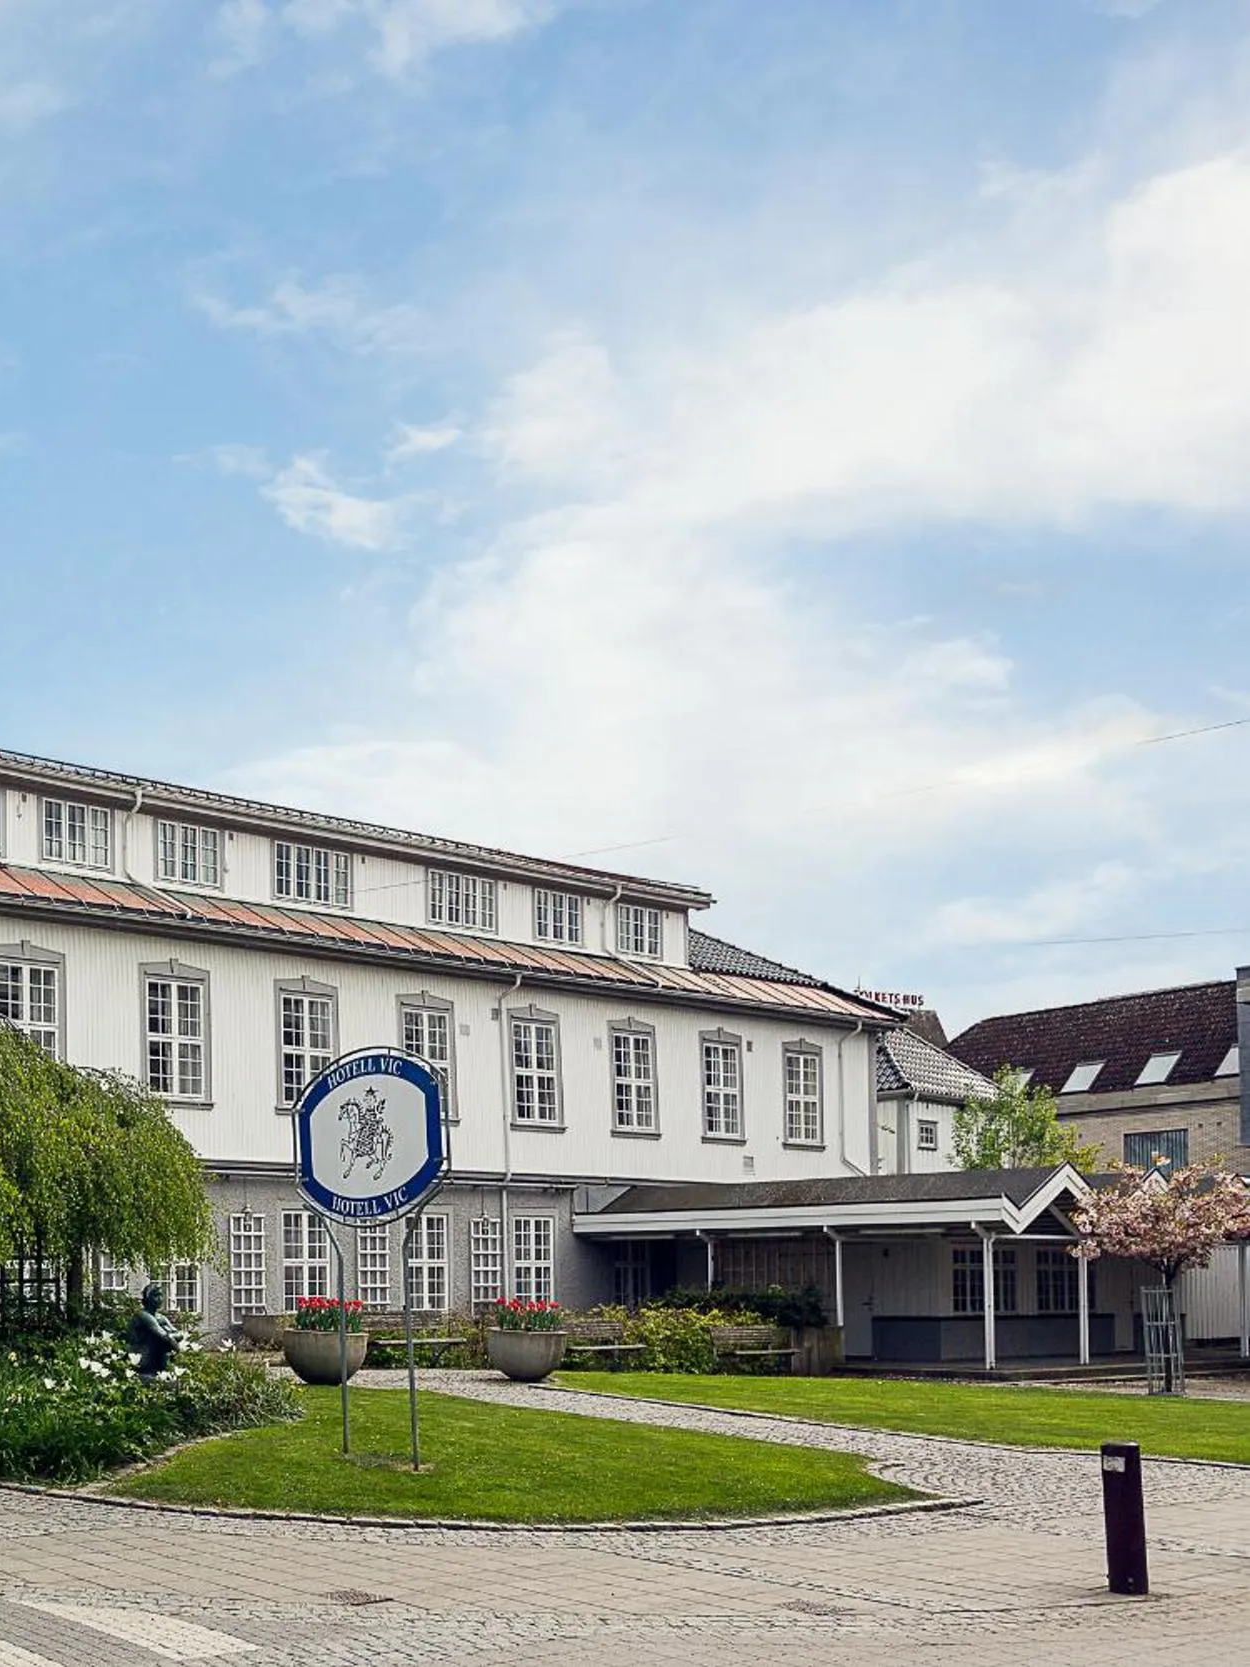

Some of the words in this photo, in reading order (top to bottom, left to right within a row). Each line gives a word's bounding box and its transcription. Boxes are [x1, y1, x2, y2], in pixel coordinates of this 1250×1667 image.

[327, 1058, 376, 1090] HOTELL
[380, 1057, 403, 1076] VIC
[331, 1195, 382, 1216] HOTELL
[384, 1186, 409, 1210] VIC
